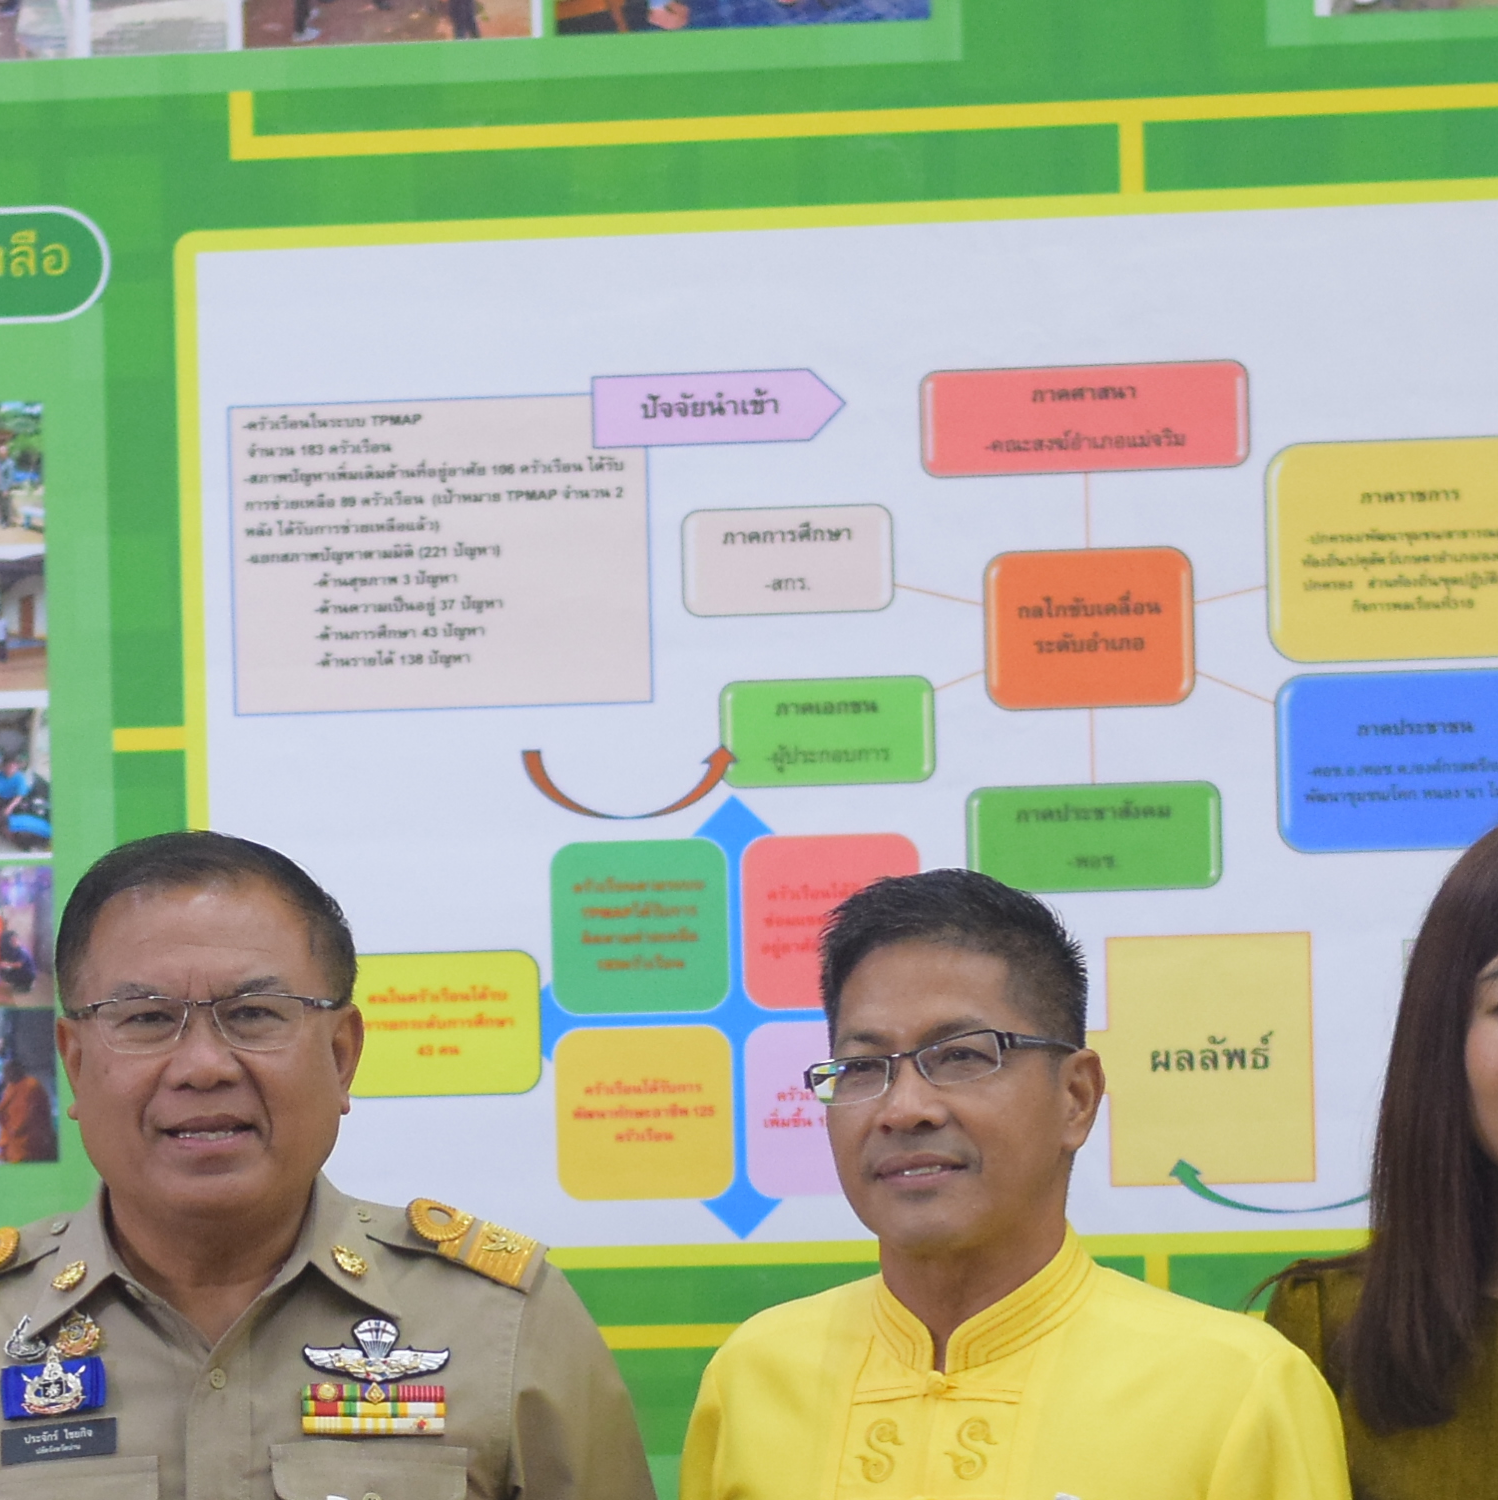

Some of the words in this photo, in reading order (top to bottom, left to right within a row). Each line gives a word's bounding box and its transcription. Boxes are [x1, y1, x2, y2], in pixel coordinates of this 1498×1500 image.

[640, 388, 781, 422] ปัจจัยนำเข้า
[722, 521, 854, 547] ภาคการศึกษา
[1017, 589, 1163, 619] กลไกขับเคลื่อน
[1034, 630, 1146, 654] ระดับอำเภอ
[1150, 1030, 1275, 1073] ผลลัพธ์
